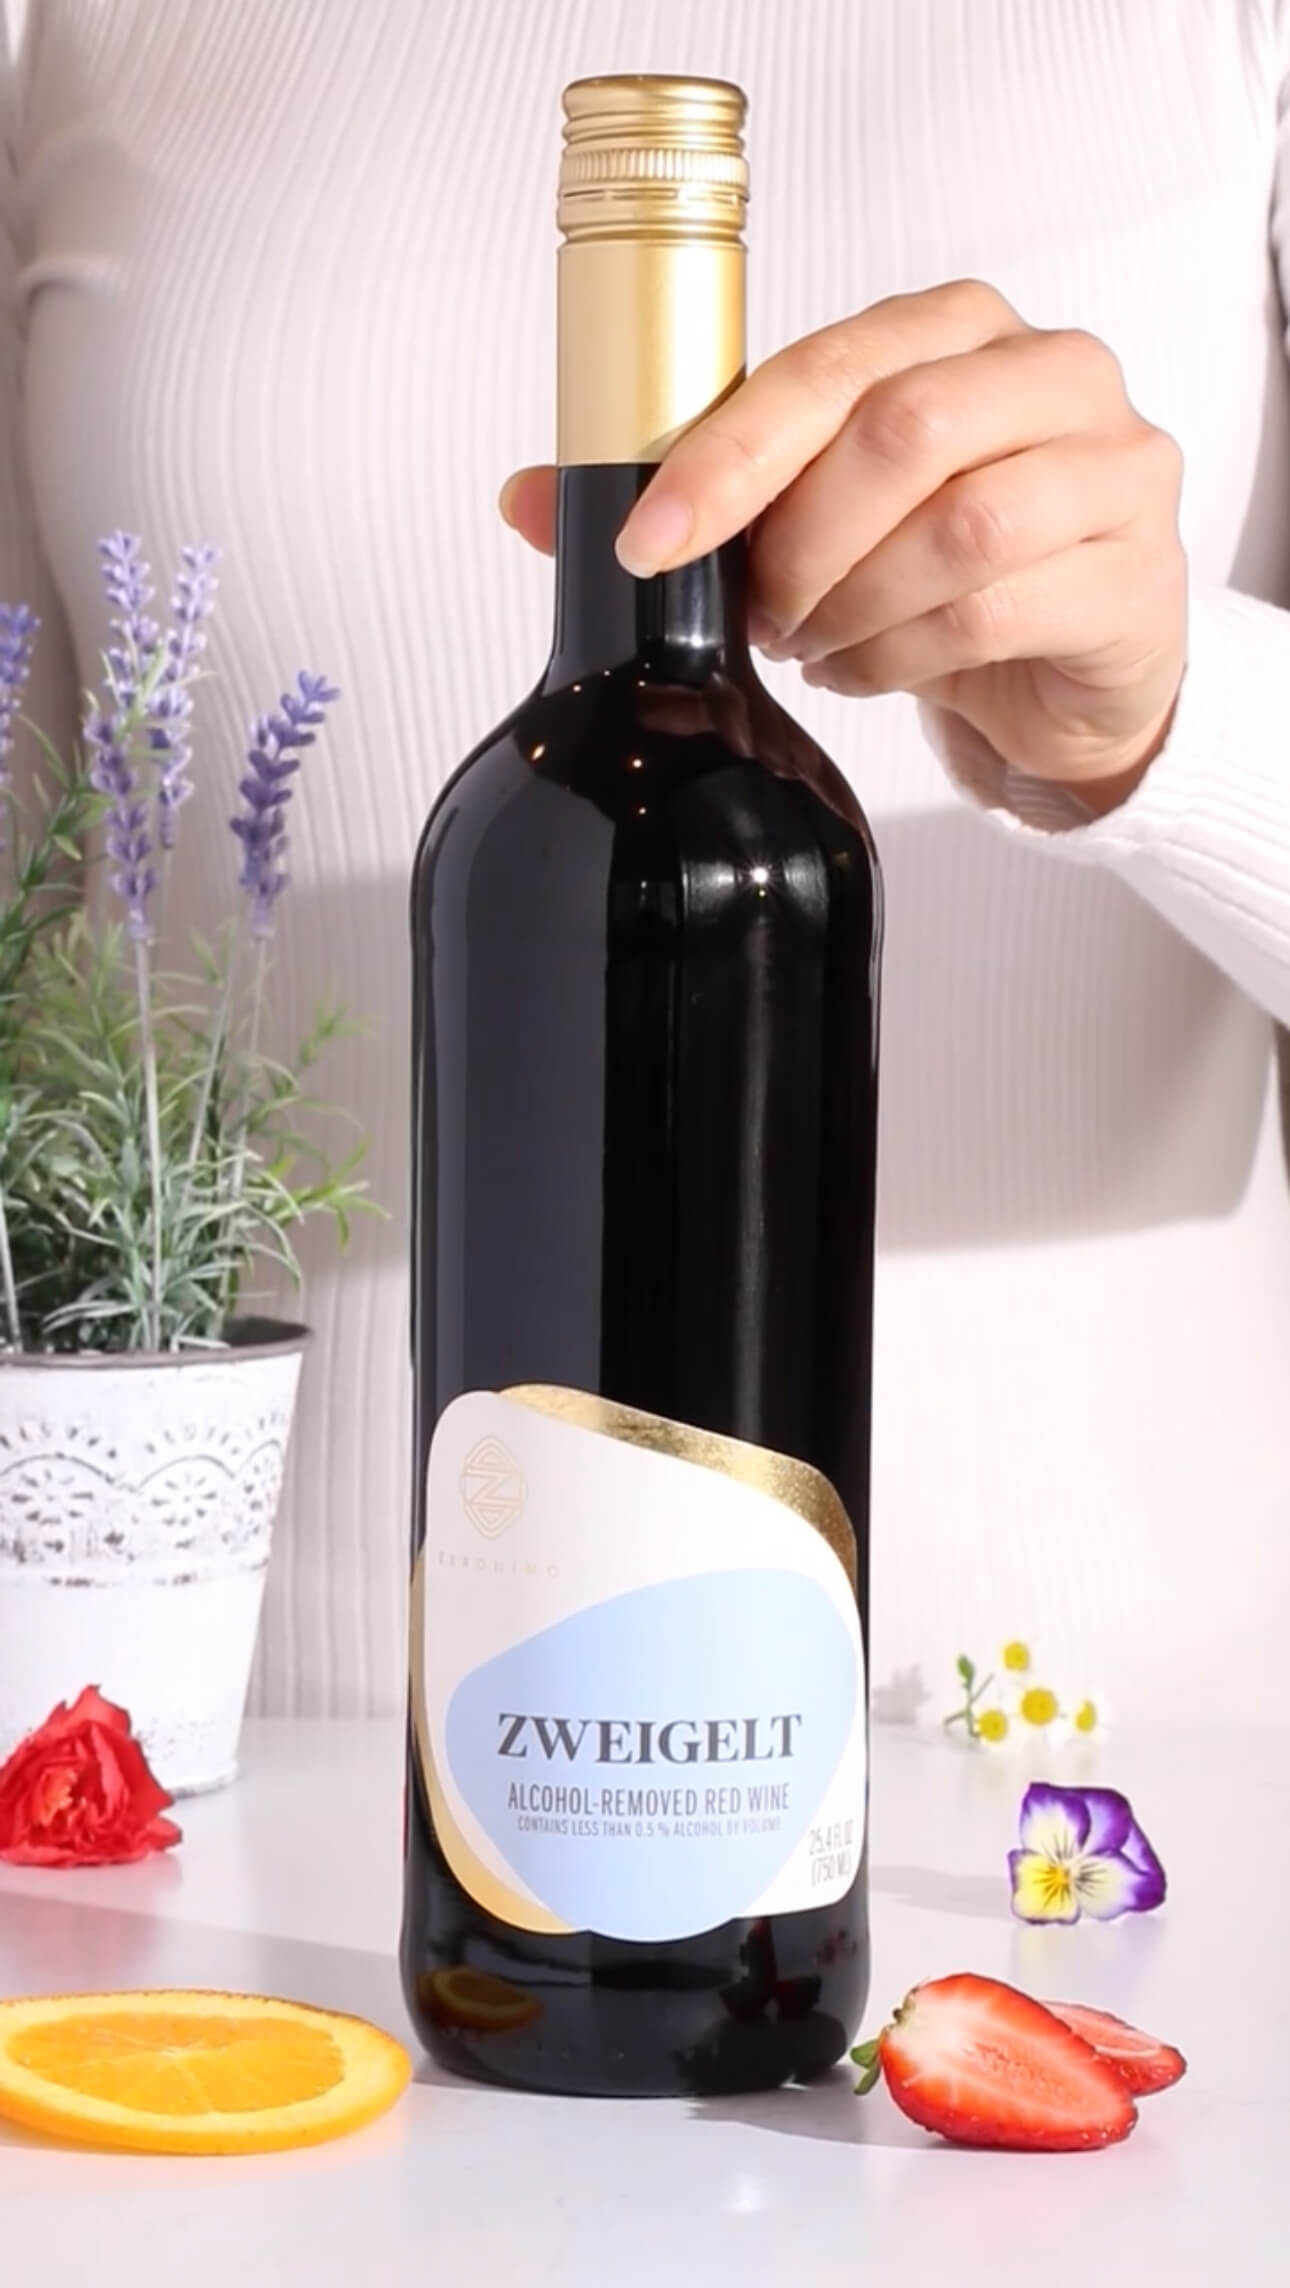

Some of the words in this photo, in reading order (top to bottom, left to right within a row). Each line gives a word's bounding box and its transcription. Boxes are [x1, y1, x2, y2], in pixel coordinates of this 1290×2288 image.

[497, 1712, 803, 1764] ZWEIGELT
[508, 1781, 697, 1816] ALCOHOL-REMOVED
[704, 1787, 742, 1815] RED
[748, 1782, 791, 1813] WINE
[518, 1815, 568, 1835] CONTAINS
[571, 1821, 599, 1837] LESS
[603, 1821, 631, 1837] THAN
[634, 1822, 656, 1838] 0.5
[657, 1821, 670, 1838] %
[674, 1820, 723, 1838] ALCOHOL
